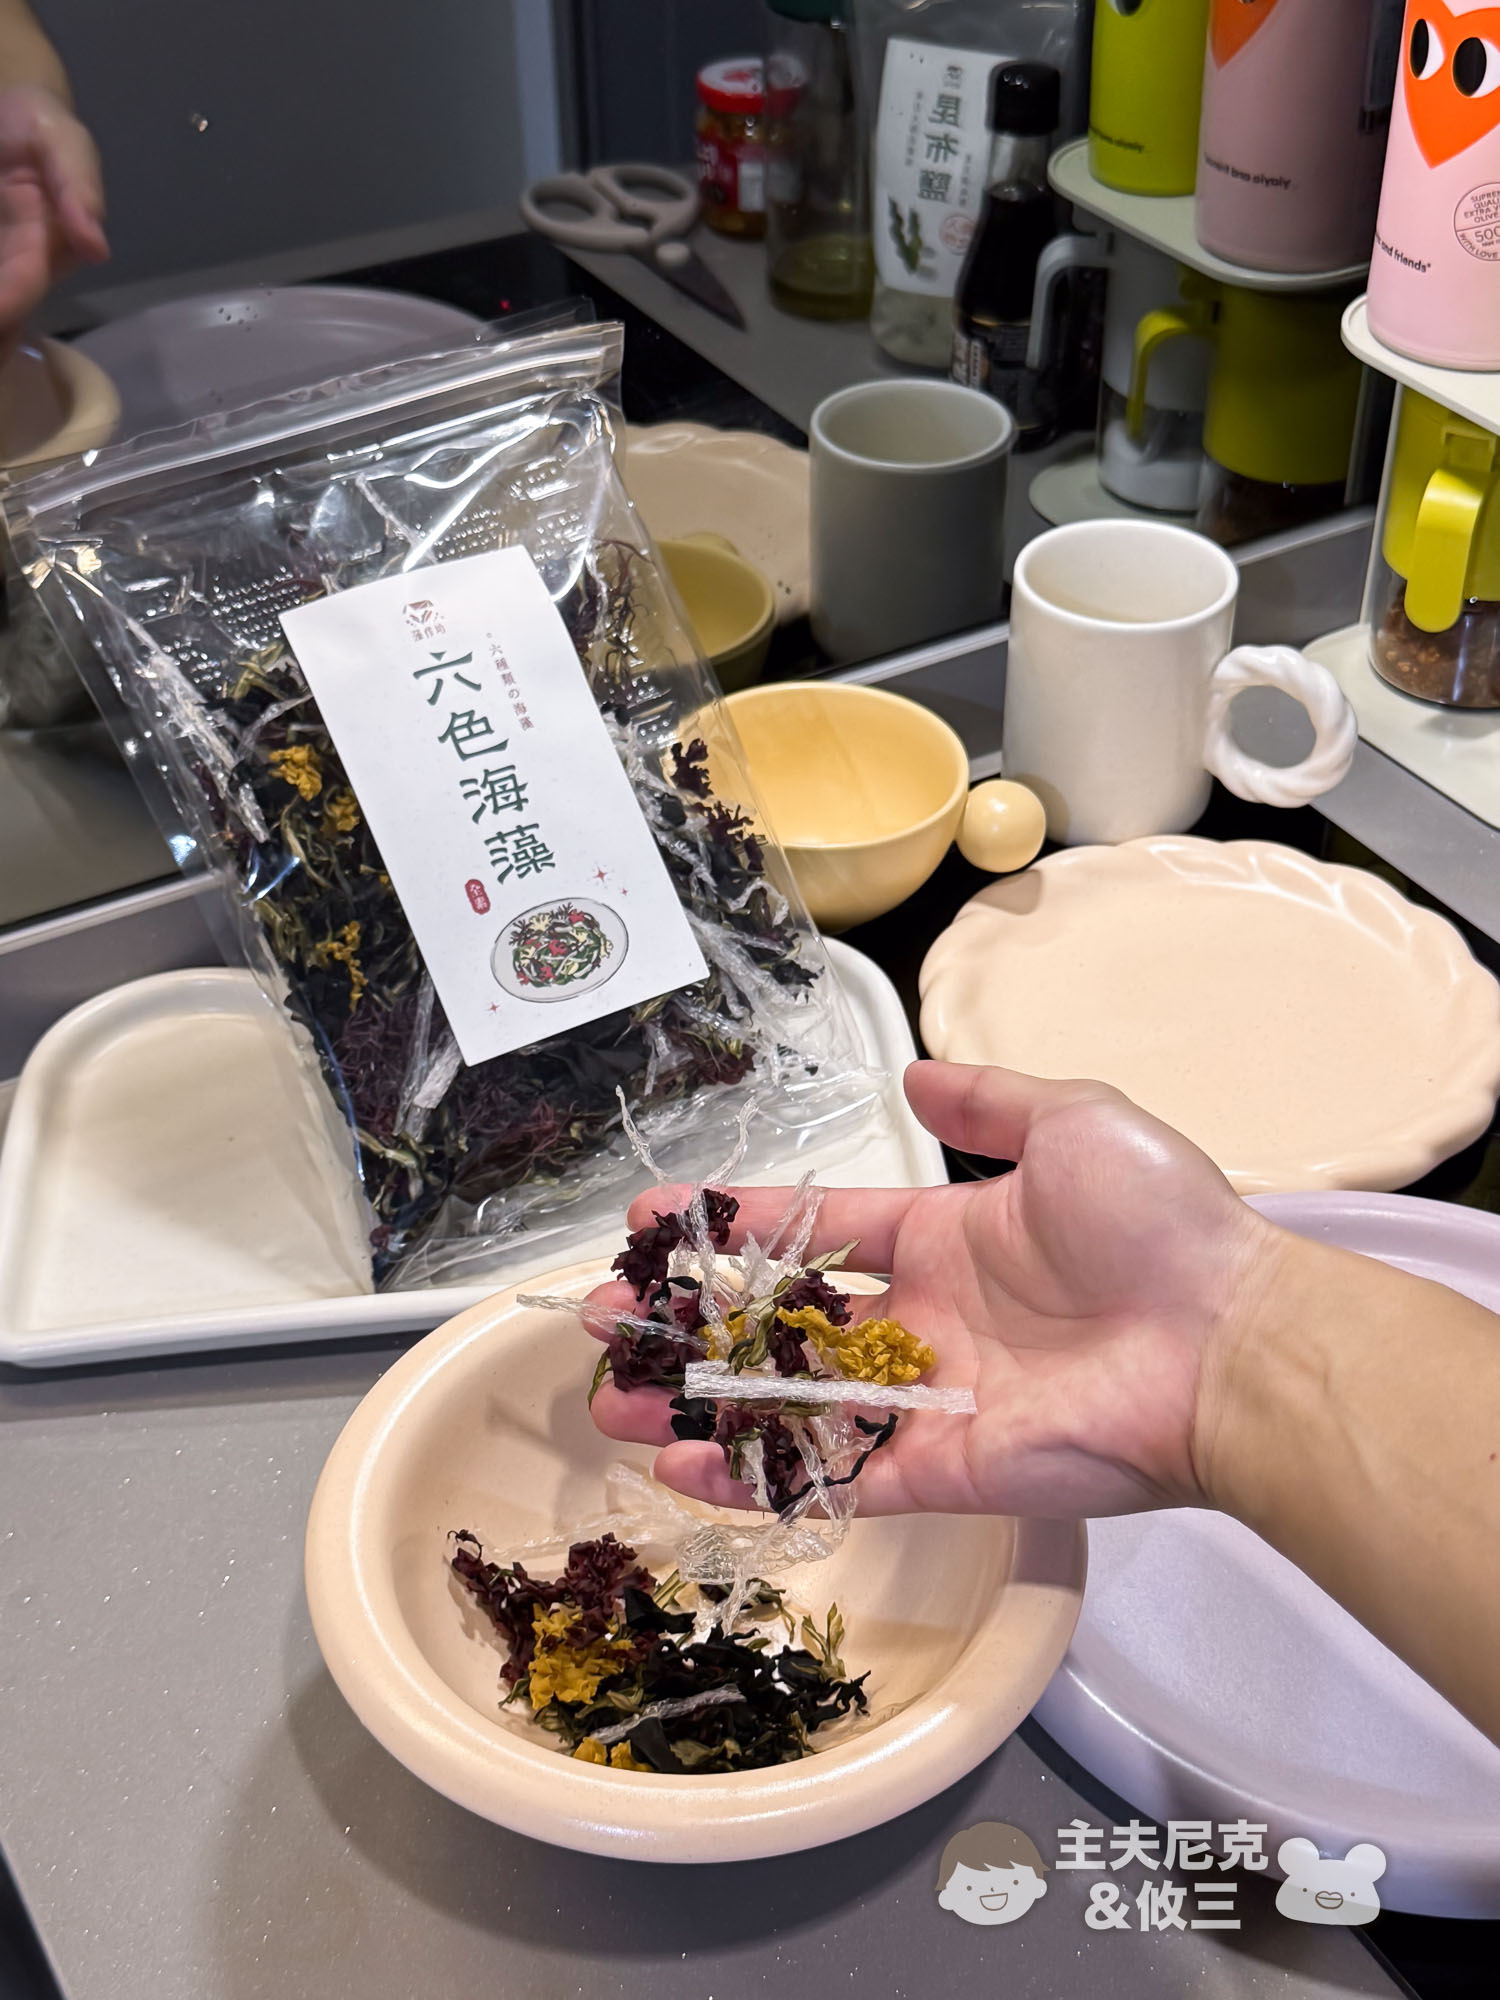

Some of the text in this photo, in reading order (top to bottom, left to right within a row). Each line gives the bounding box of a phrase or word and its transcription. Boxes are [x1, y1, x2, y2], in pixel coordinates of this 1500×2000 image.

[1475, 248, 1498, 258] LOVE
[412, 650, 556, 884] 六色海藻
